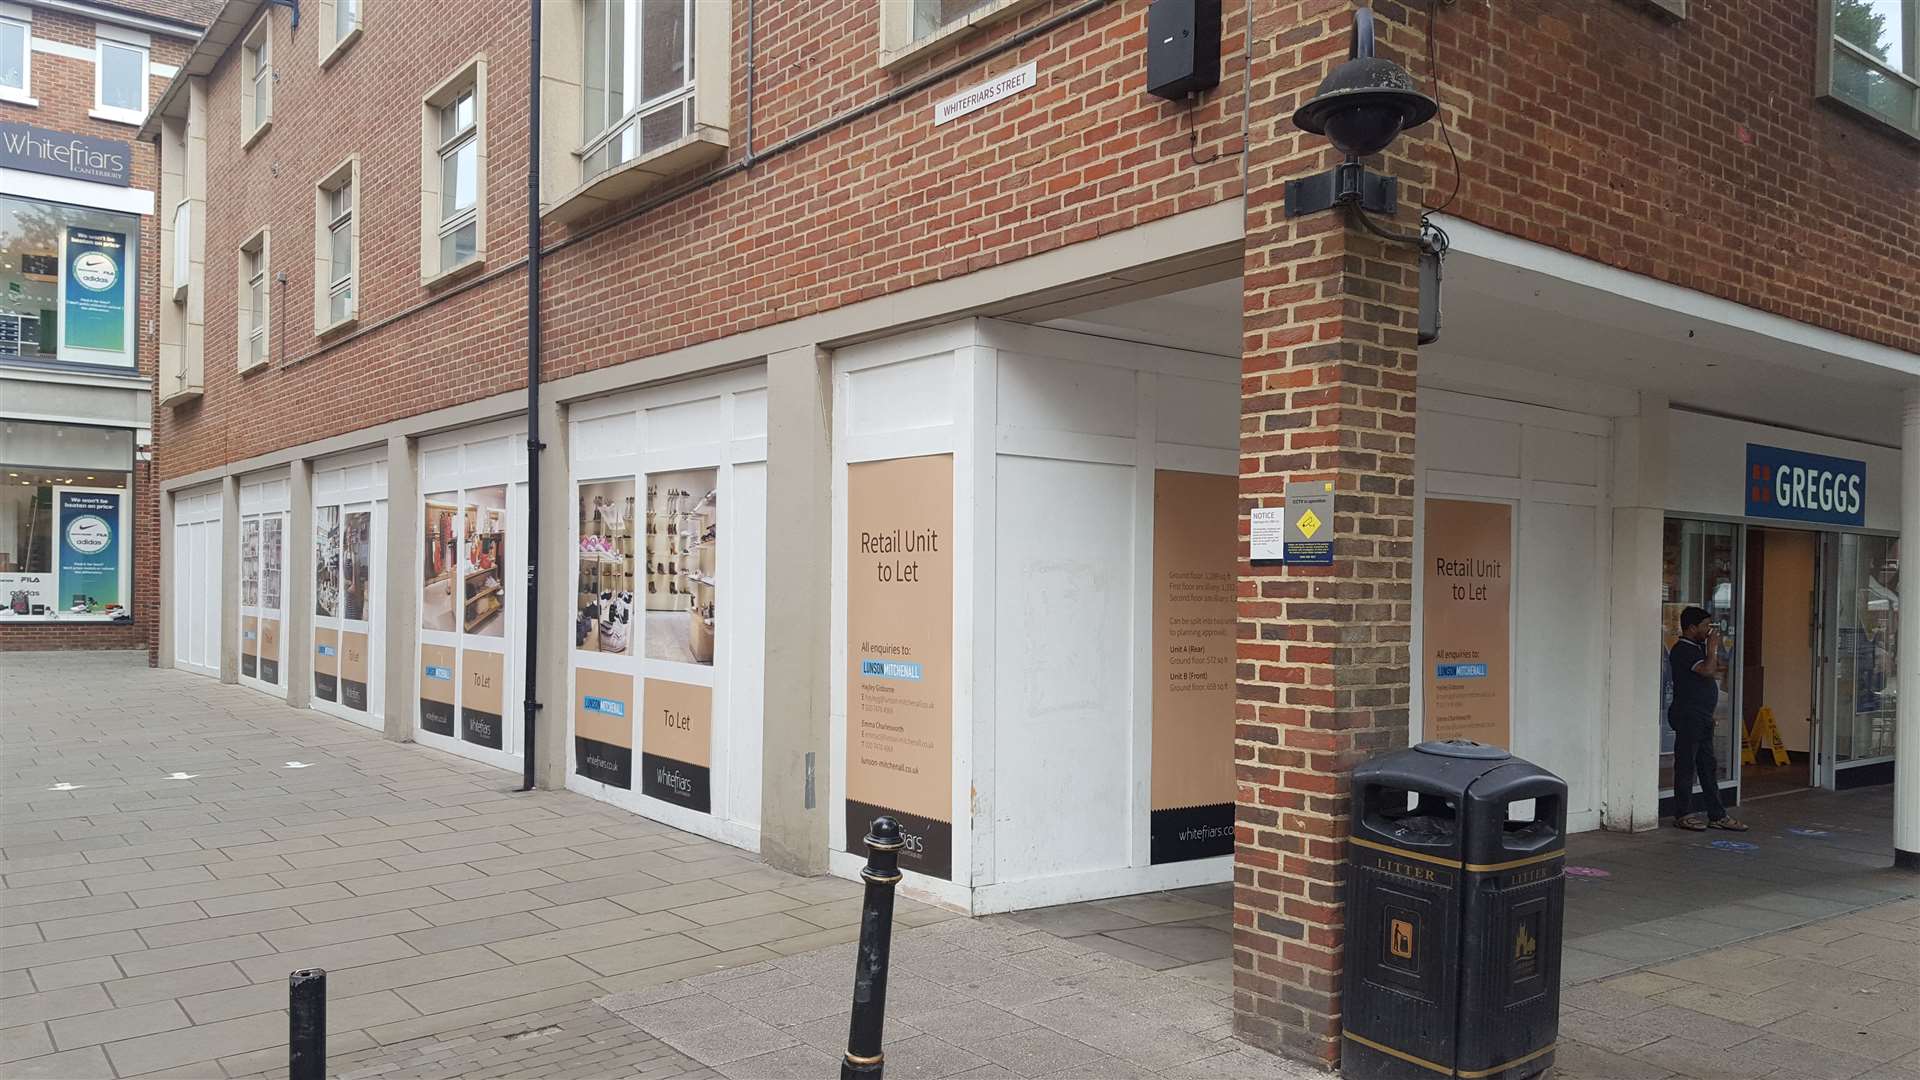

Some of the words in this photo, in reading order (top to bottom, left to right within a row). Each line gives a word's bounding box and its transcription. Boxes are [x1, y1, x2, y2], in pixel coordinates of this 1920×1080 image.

[943, 86, 994, 117] WHITEFRIARS
[996, 73, 1027, 96] STREET
[3, 131, 123, 171] Whitefriars
[74, 166, 122, 179] CANTERBURY
[83, 275, 109, 284] adidas
[1776, 465, 1860, 514] GREGGS
[1253, 511, 1275, 520] NOTICE
[76, 538, 102, 546] adidas
[861, 529, 901, 554] Retail
[905, 528, 939, 552] Unit
[877, 561, 892, 582] to
[896, 560, 919, 582] Let
[1436, 557, 1473, 577] Retail
[1477, 559, 1502, 578] Unit
[1452, 583, 1466, 600] to
[1469, 583, 1487, 600] Let
[861, 641, 870, 653] All
[871, 643, 901, 656] enquiries
[902, 645, 912, 656] to:
[1169, 645, 1182, 654] Unit
[1183, 645, 1188, 653] A
[1188, 645, 1205, 656] (Rear)
[1436, 650, 1445, 659] All
[1445, 650, 1471, 660] enquiries
[1169, 673, 1182, 681] Unit
[1188, 671, 1208, 681] (Front)
[663, 709, 675, 728] To
[676, 711, 691, 731] Let
[1377, 857, 1436, 882] LITTER
[1511, 866, 1548, 885] LITTER
